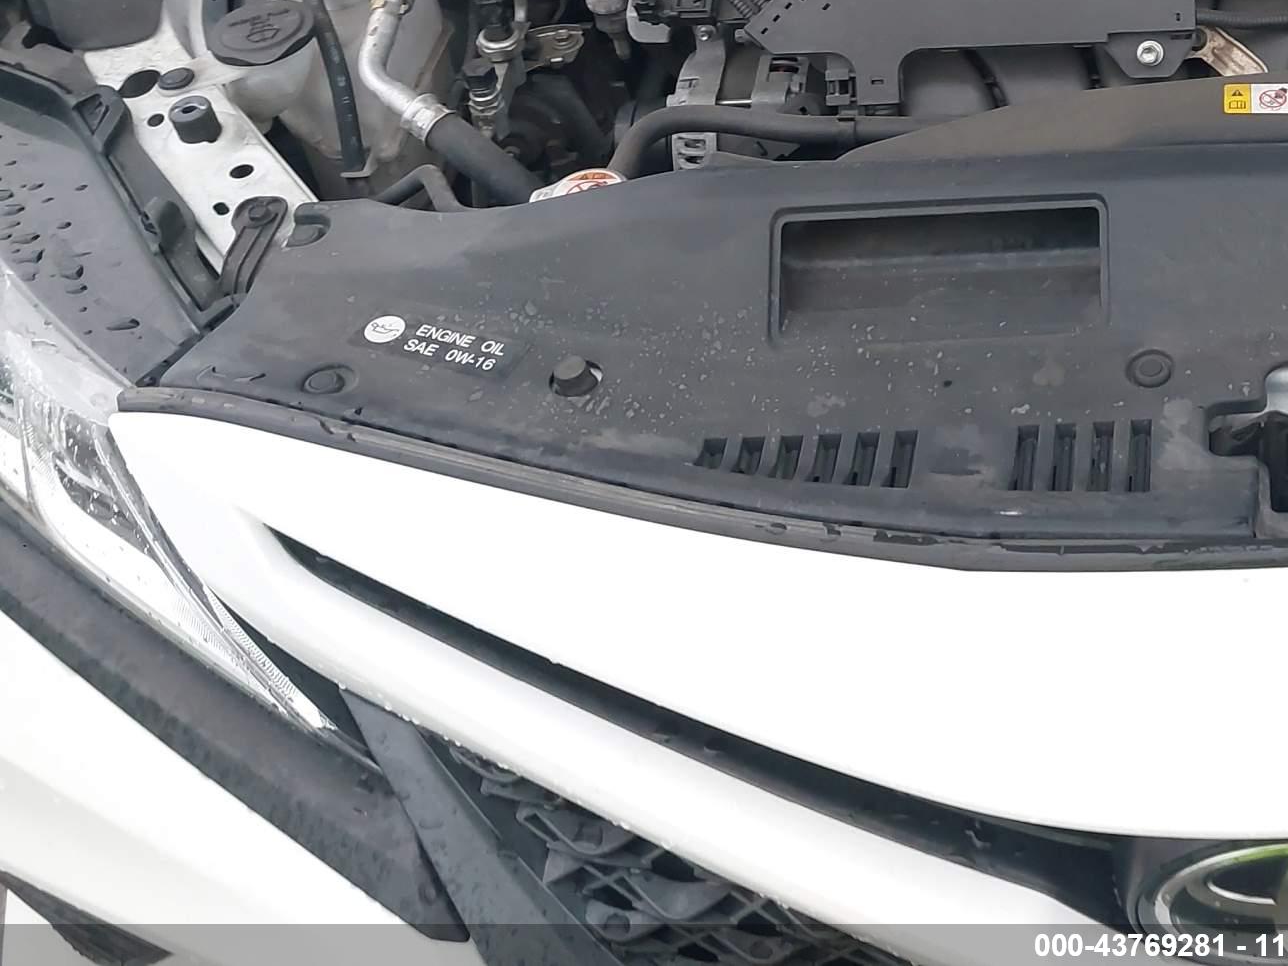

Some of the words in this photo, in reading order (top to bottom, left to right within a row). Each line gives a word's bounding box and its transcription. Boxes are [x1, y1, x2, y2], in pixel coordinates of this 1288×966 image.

[403, 339, 440, 356] SAE
[444, 349, 496, 370] 0W-16
[416, 324, 476, 347] ENGINE
[480, 340, 505, 356] OIL
